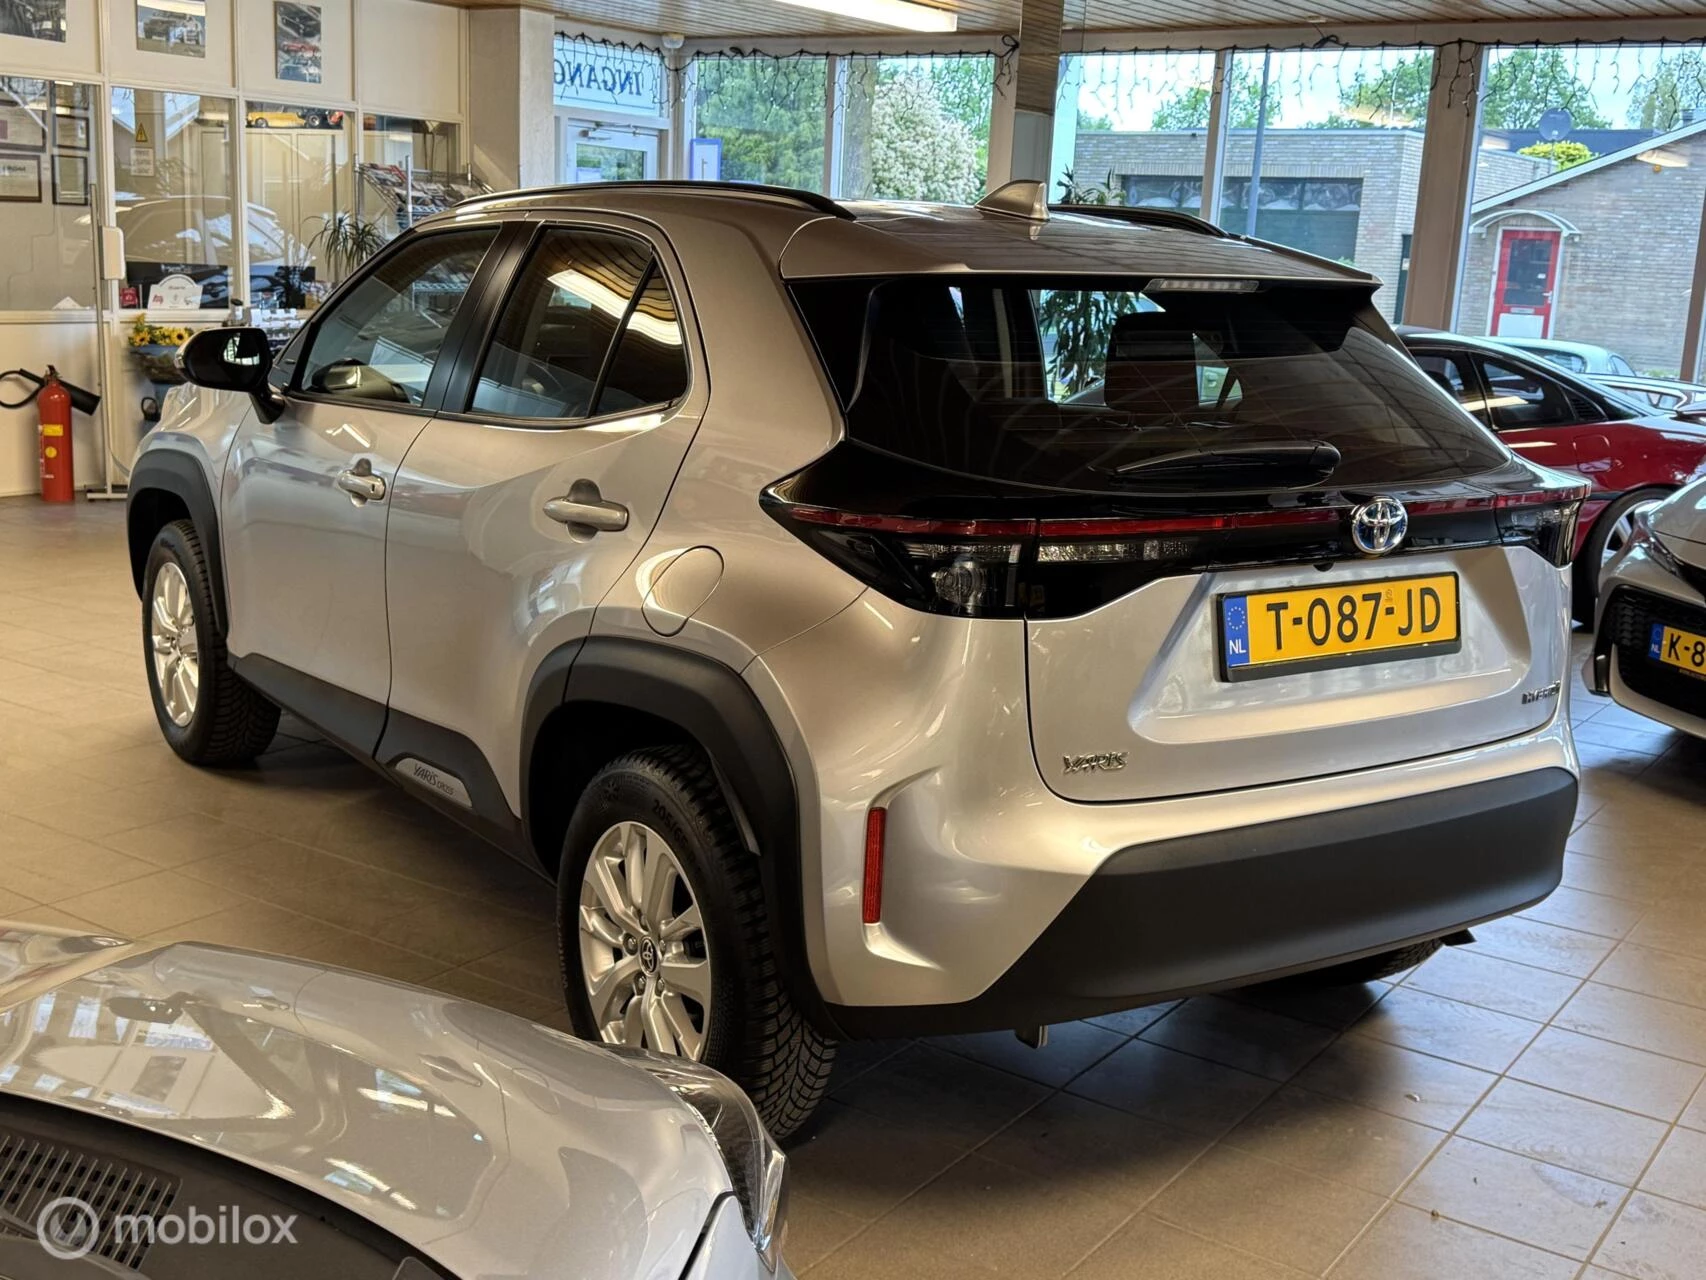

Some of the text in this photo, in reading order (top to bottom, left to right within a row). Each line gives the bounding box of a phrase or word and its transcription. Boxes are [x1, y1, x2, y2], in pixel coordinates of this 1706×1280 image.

[1266, 587, 1441, 651] T-087-JD
[1229, 639, 1247, 654] NL
[413, 763, 438, 786] YARIS
